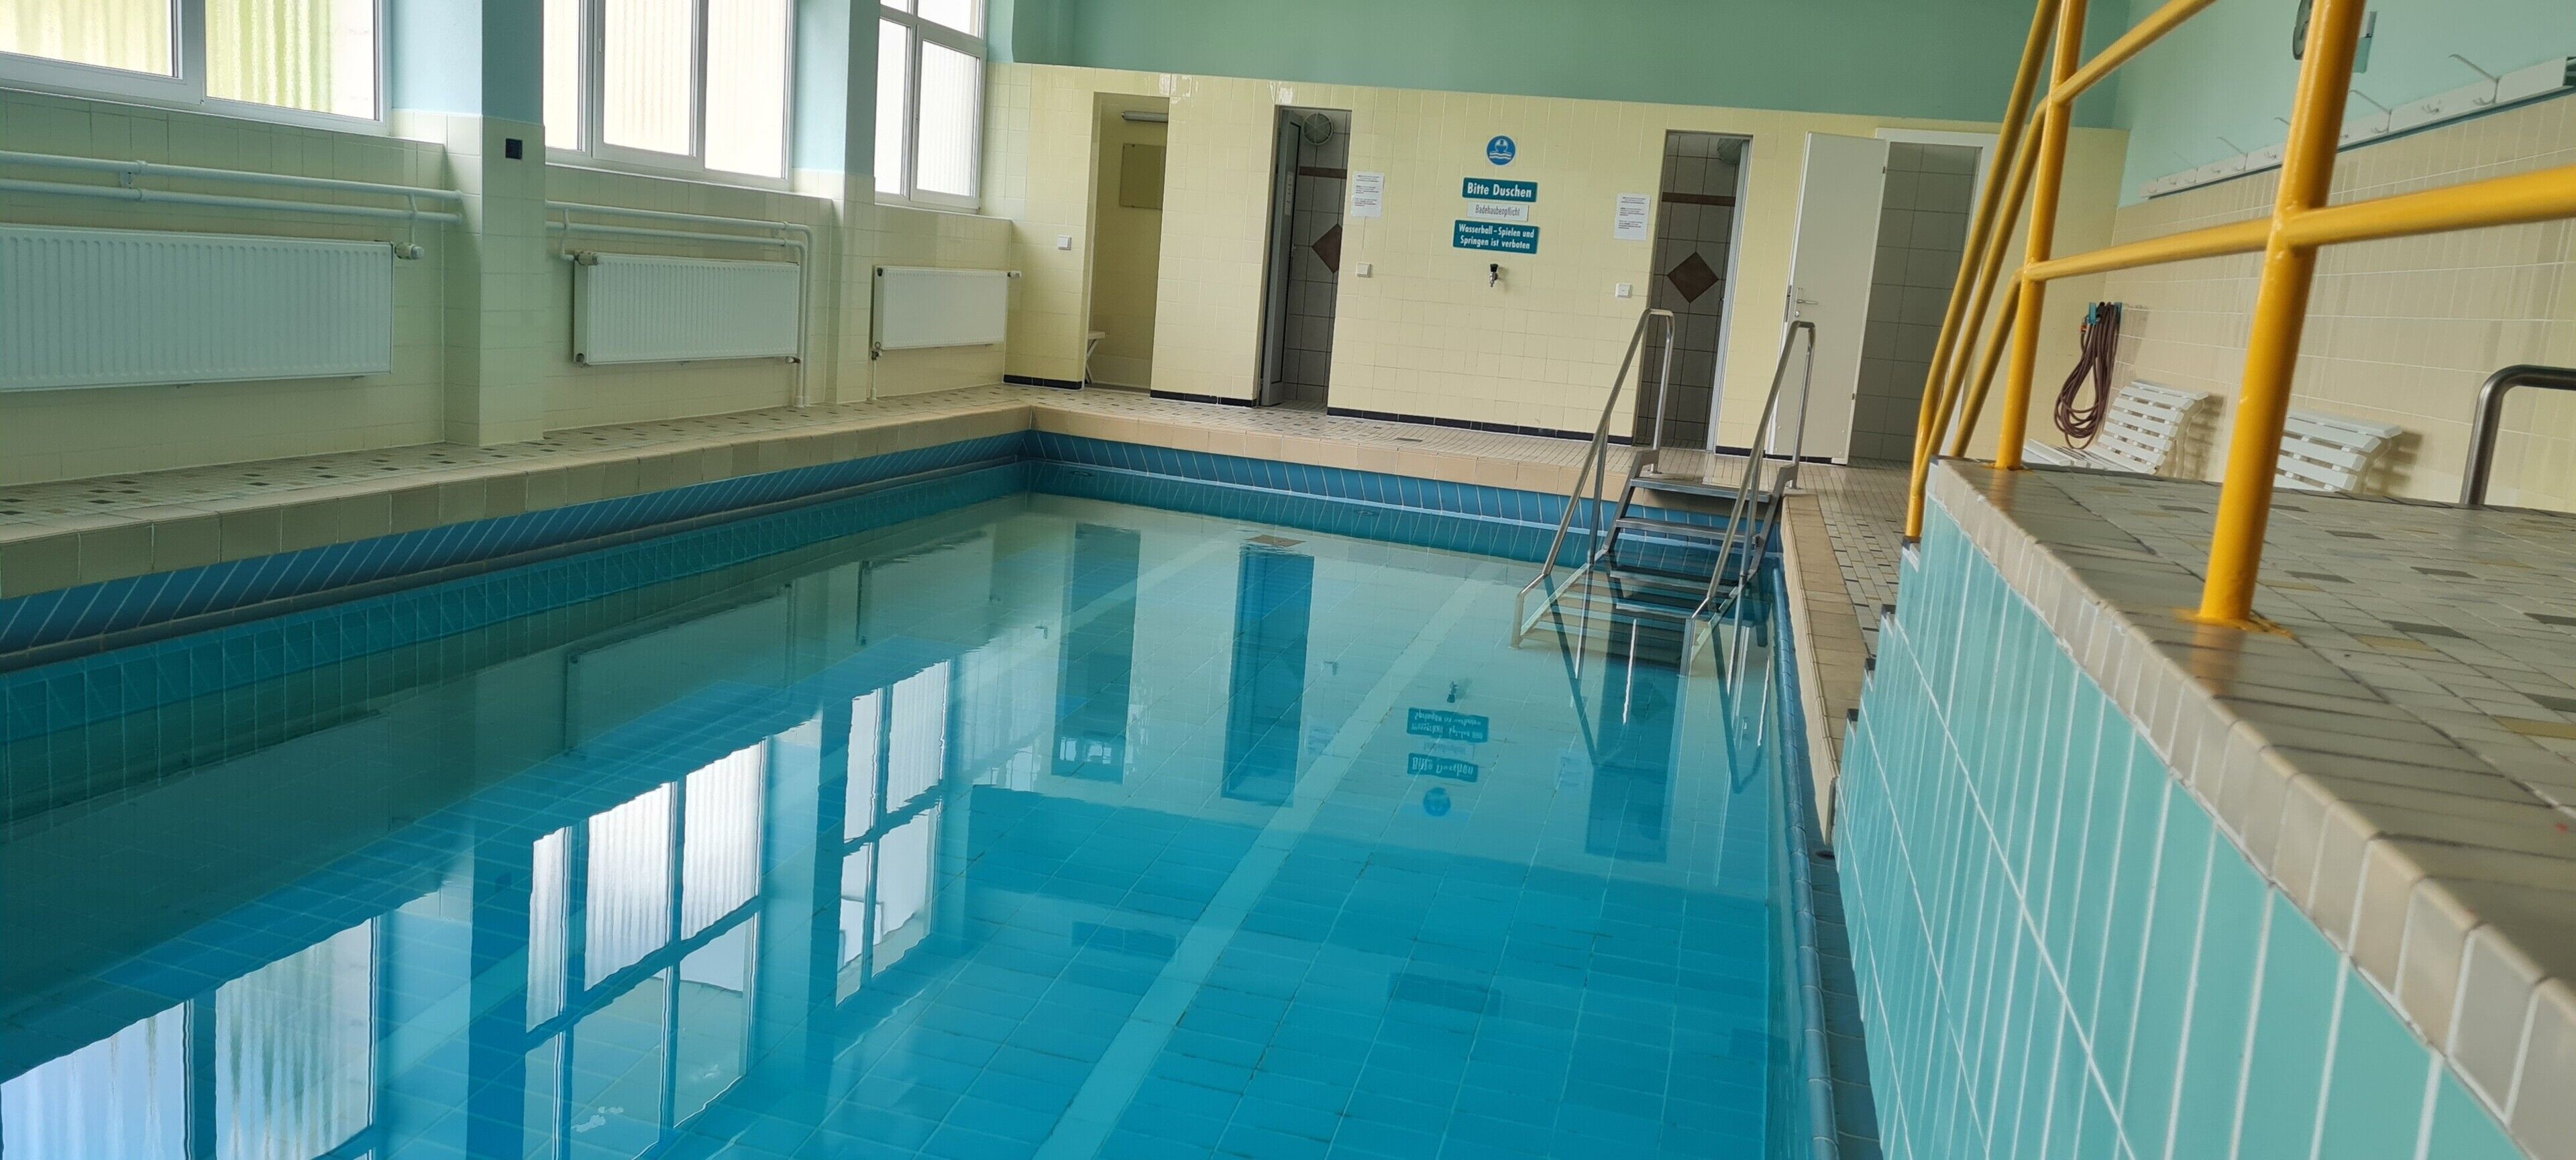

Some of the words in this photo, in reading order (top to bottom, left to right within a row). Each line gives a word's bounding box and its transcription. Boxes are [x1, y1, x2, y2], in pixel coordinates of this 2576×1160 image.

[1467, 182, 1489, 195] Bitte
[1493, 184, 1532, 198] Duschen
[1475, 204, 1520, 217] Badehaubenpflicht
[1522, 229, 1535, 238] und
[1460, 235, 1489, 248] Springen
[1491, 238, 1499, 246] ist
[1501, 239, 1530, 250] verboten
